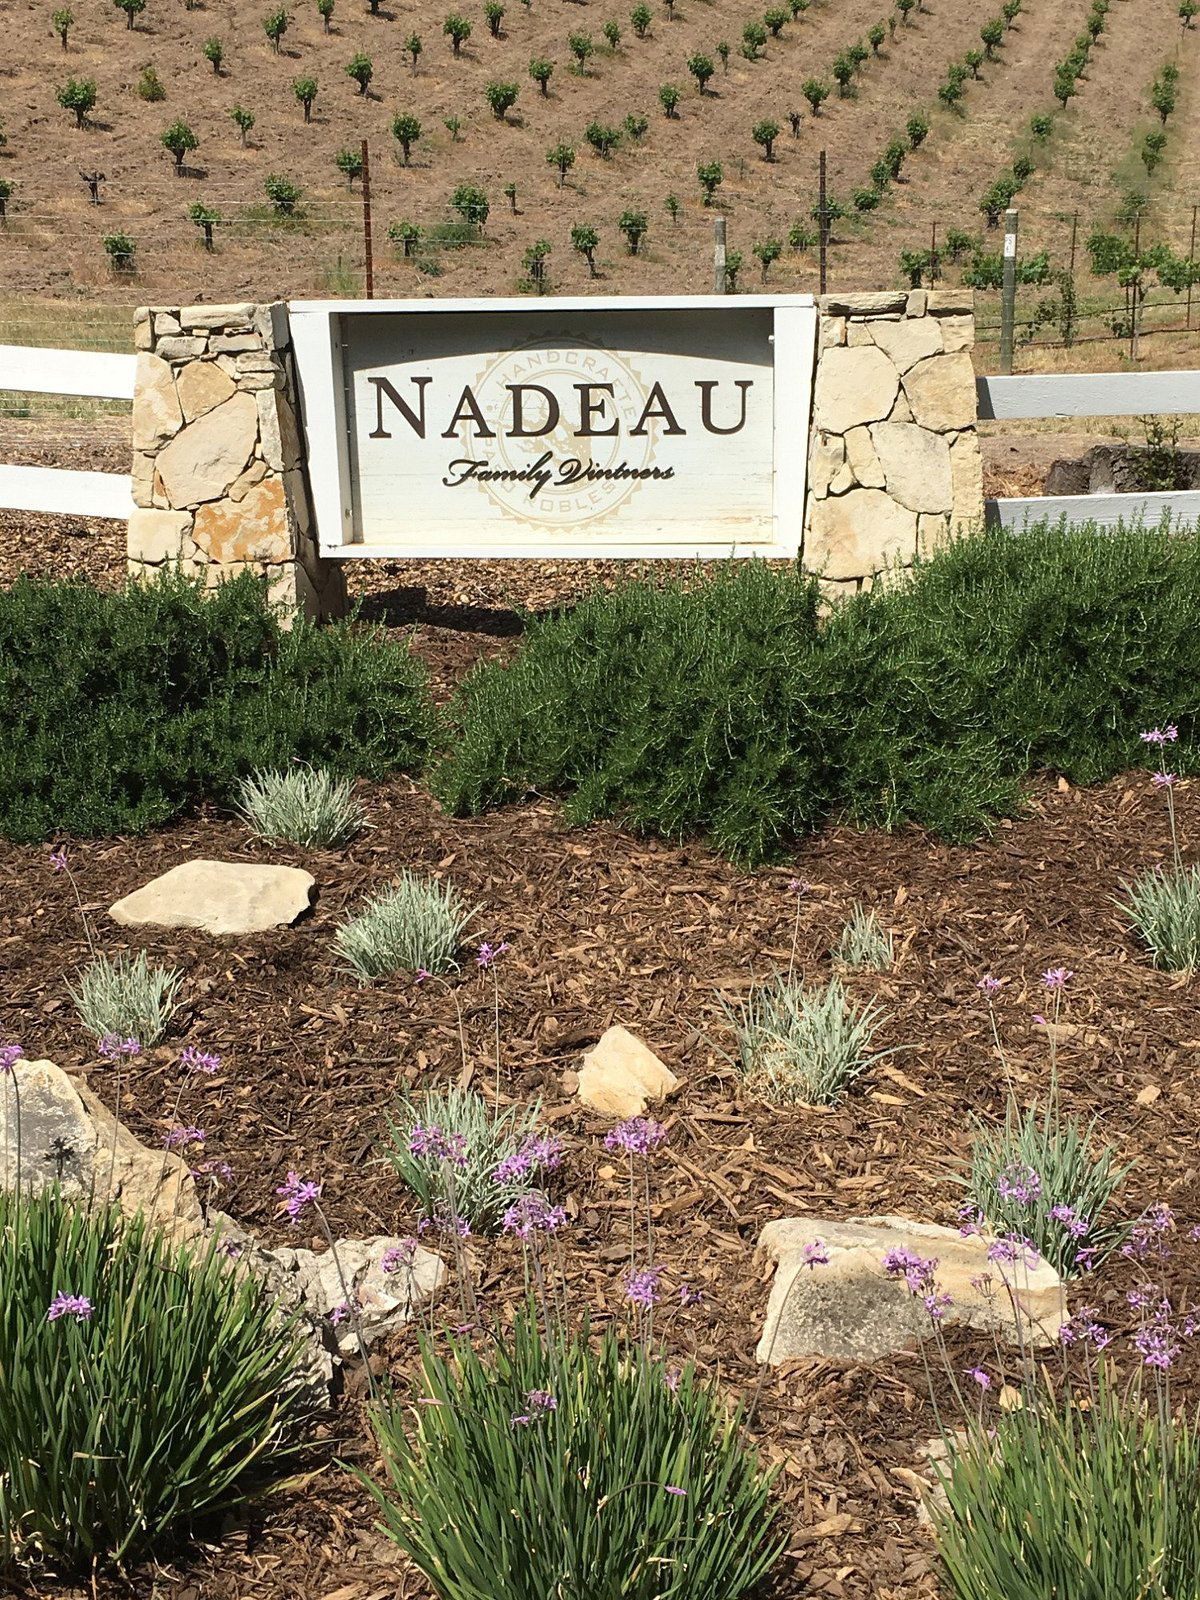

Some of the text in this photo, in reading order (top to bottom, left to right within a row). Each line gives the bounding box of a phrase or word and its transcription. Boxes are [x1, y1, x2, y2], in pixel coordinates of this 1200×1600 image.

[368, 376, 753, 439] NADEAU
[442, 451, 675, 499] Family Vintners
